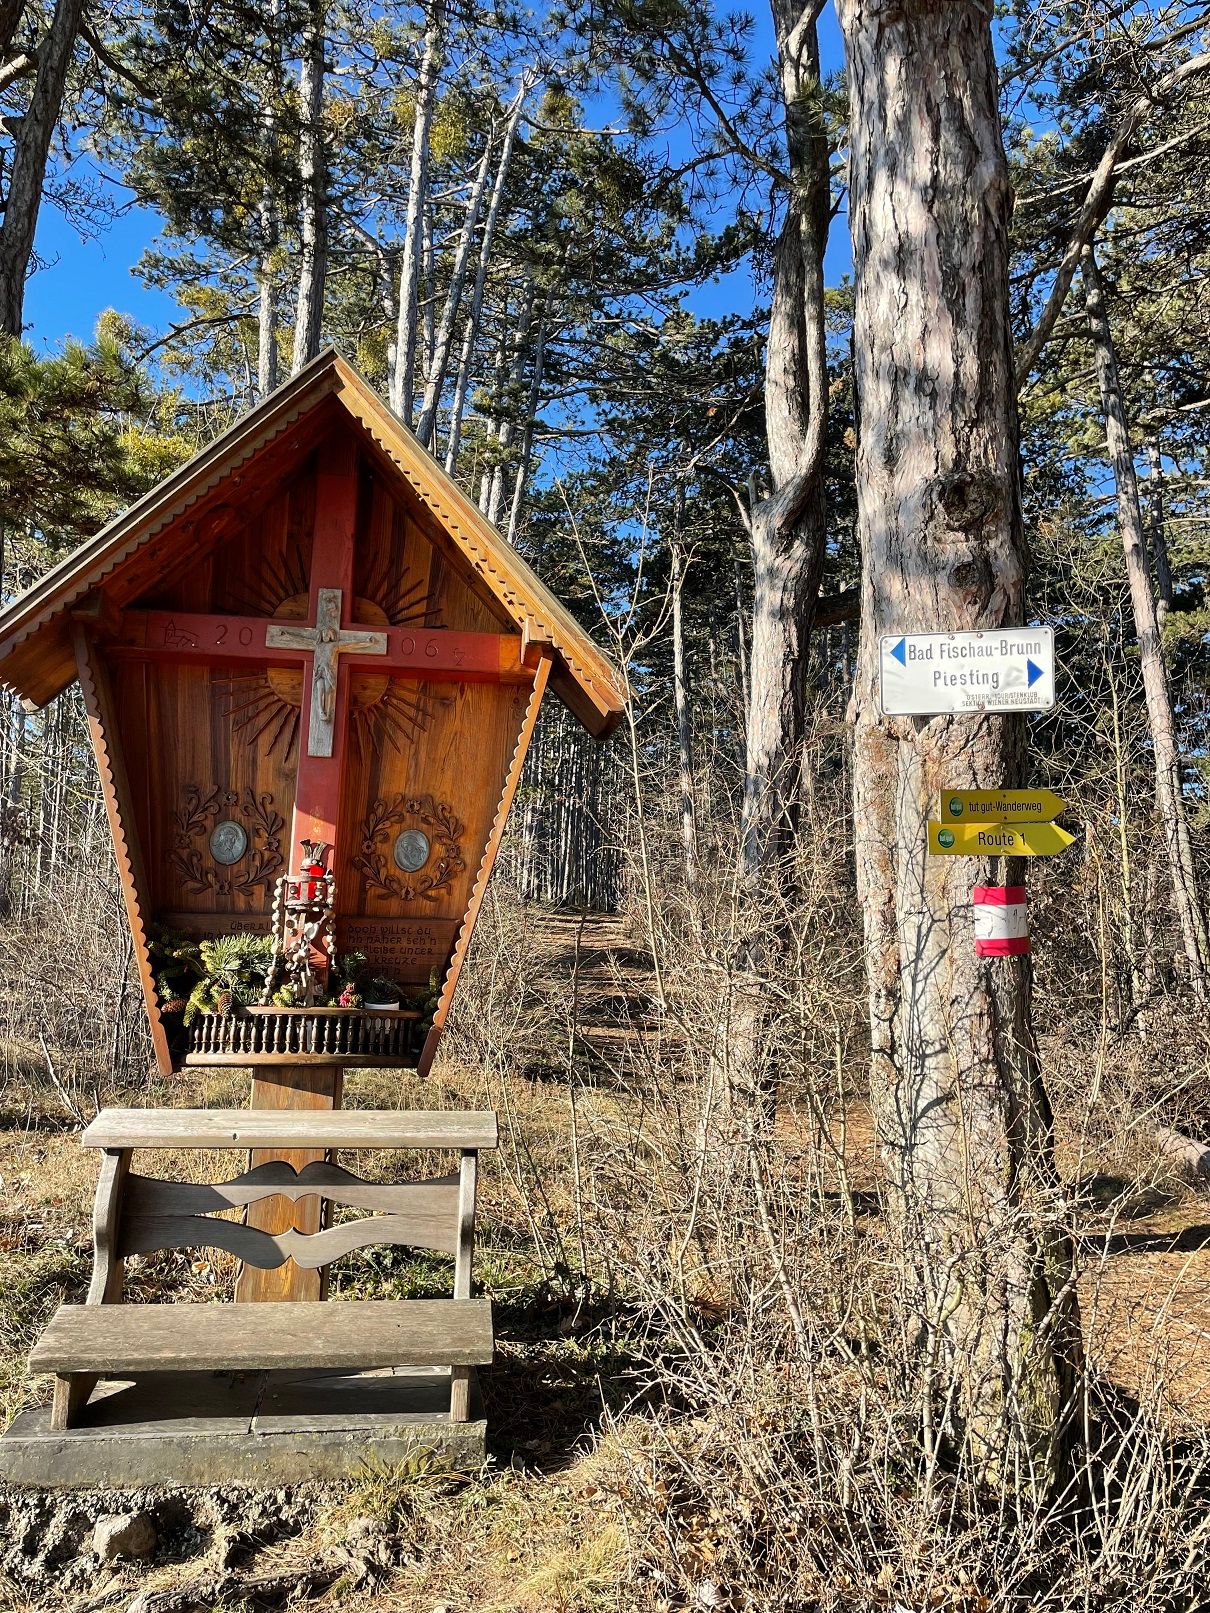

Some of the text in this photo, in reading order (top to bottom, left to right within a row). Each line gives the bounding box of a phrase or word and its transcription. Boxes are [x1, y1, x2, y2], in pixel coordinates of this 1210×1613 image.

[908, 639, 1042, 661] Bad Fischau-Brunn
[933, 670, 1000, 689] Piesting
[968, 802, 980, 812] tut
[981, 801, 1042, 814] gut-Wanderweg
[978, 831, 1026, 846] Route 1
